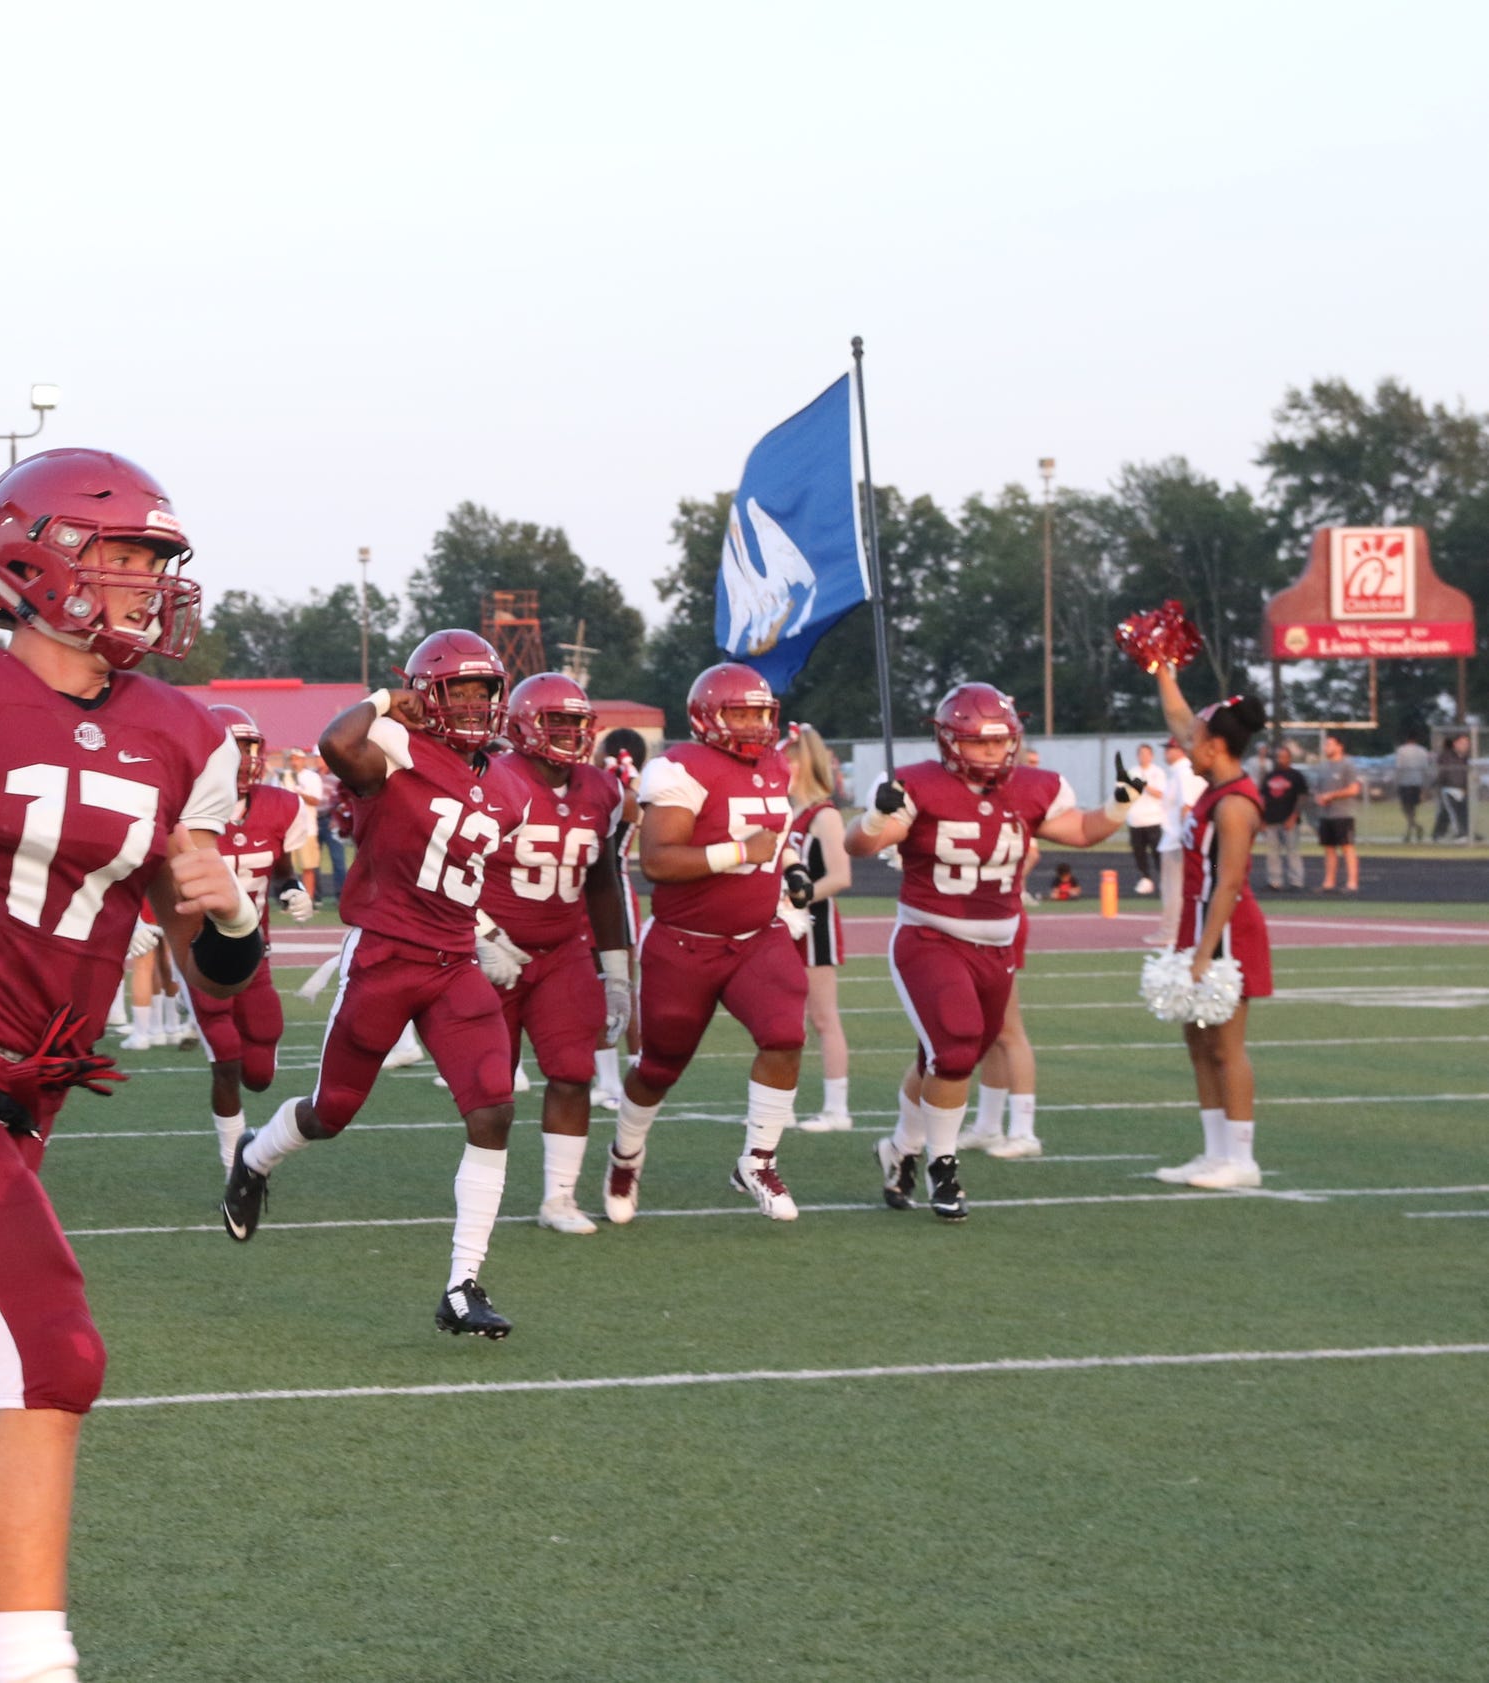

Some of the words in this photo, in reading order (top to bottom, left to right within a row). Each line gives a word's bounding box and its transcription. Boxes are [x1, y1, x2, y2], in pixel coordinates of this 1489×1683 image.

[4, 763, 160, 942] 17
[416, 797, 500, 908] 13
[510, 824, 599, 904] 50
[728, 796, 794, 876] 57
[933, 820, 1025, 895] 54
